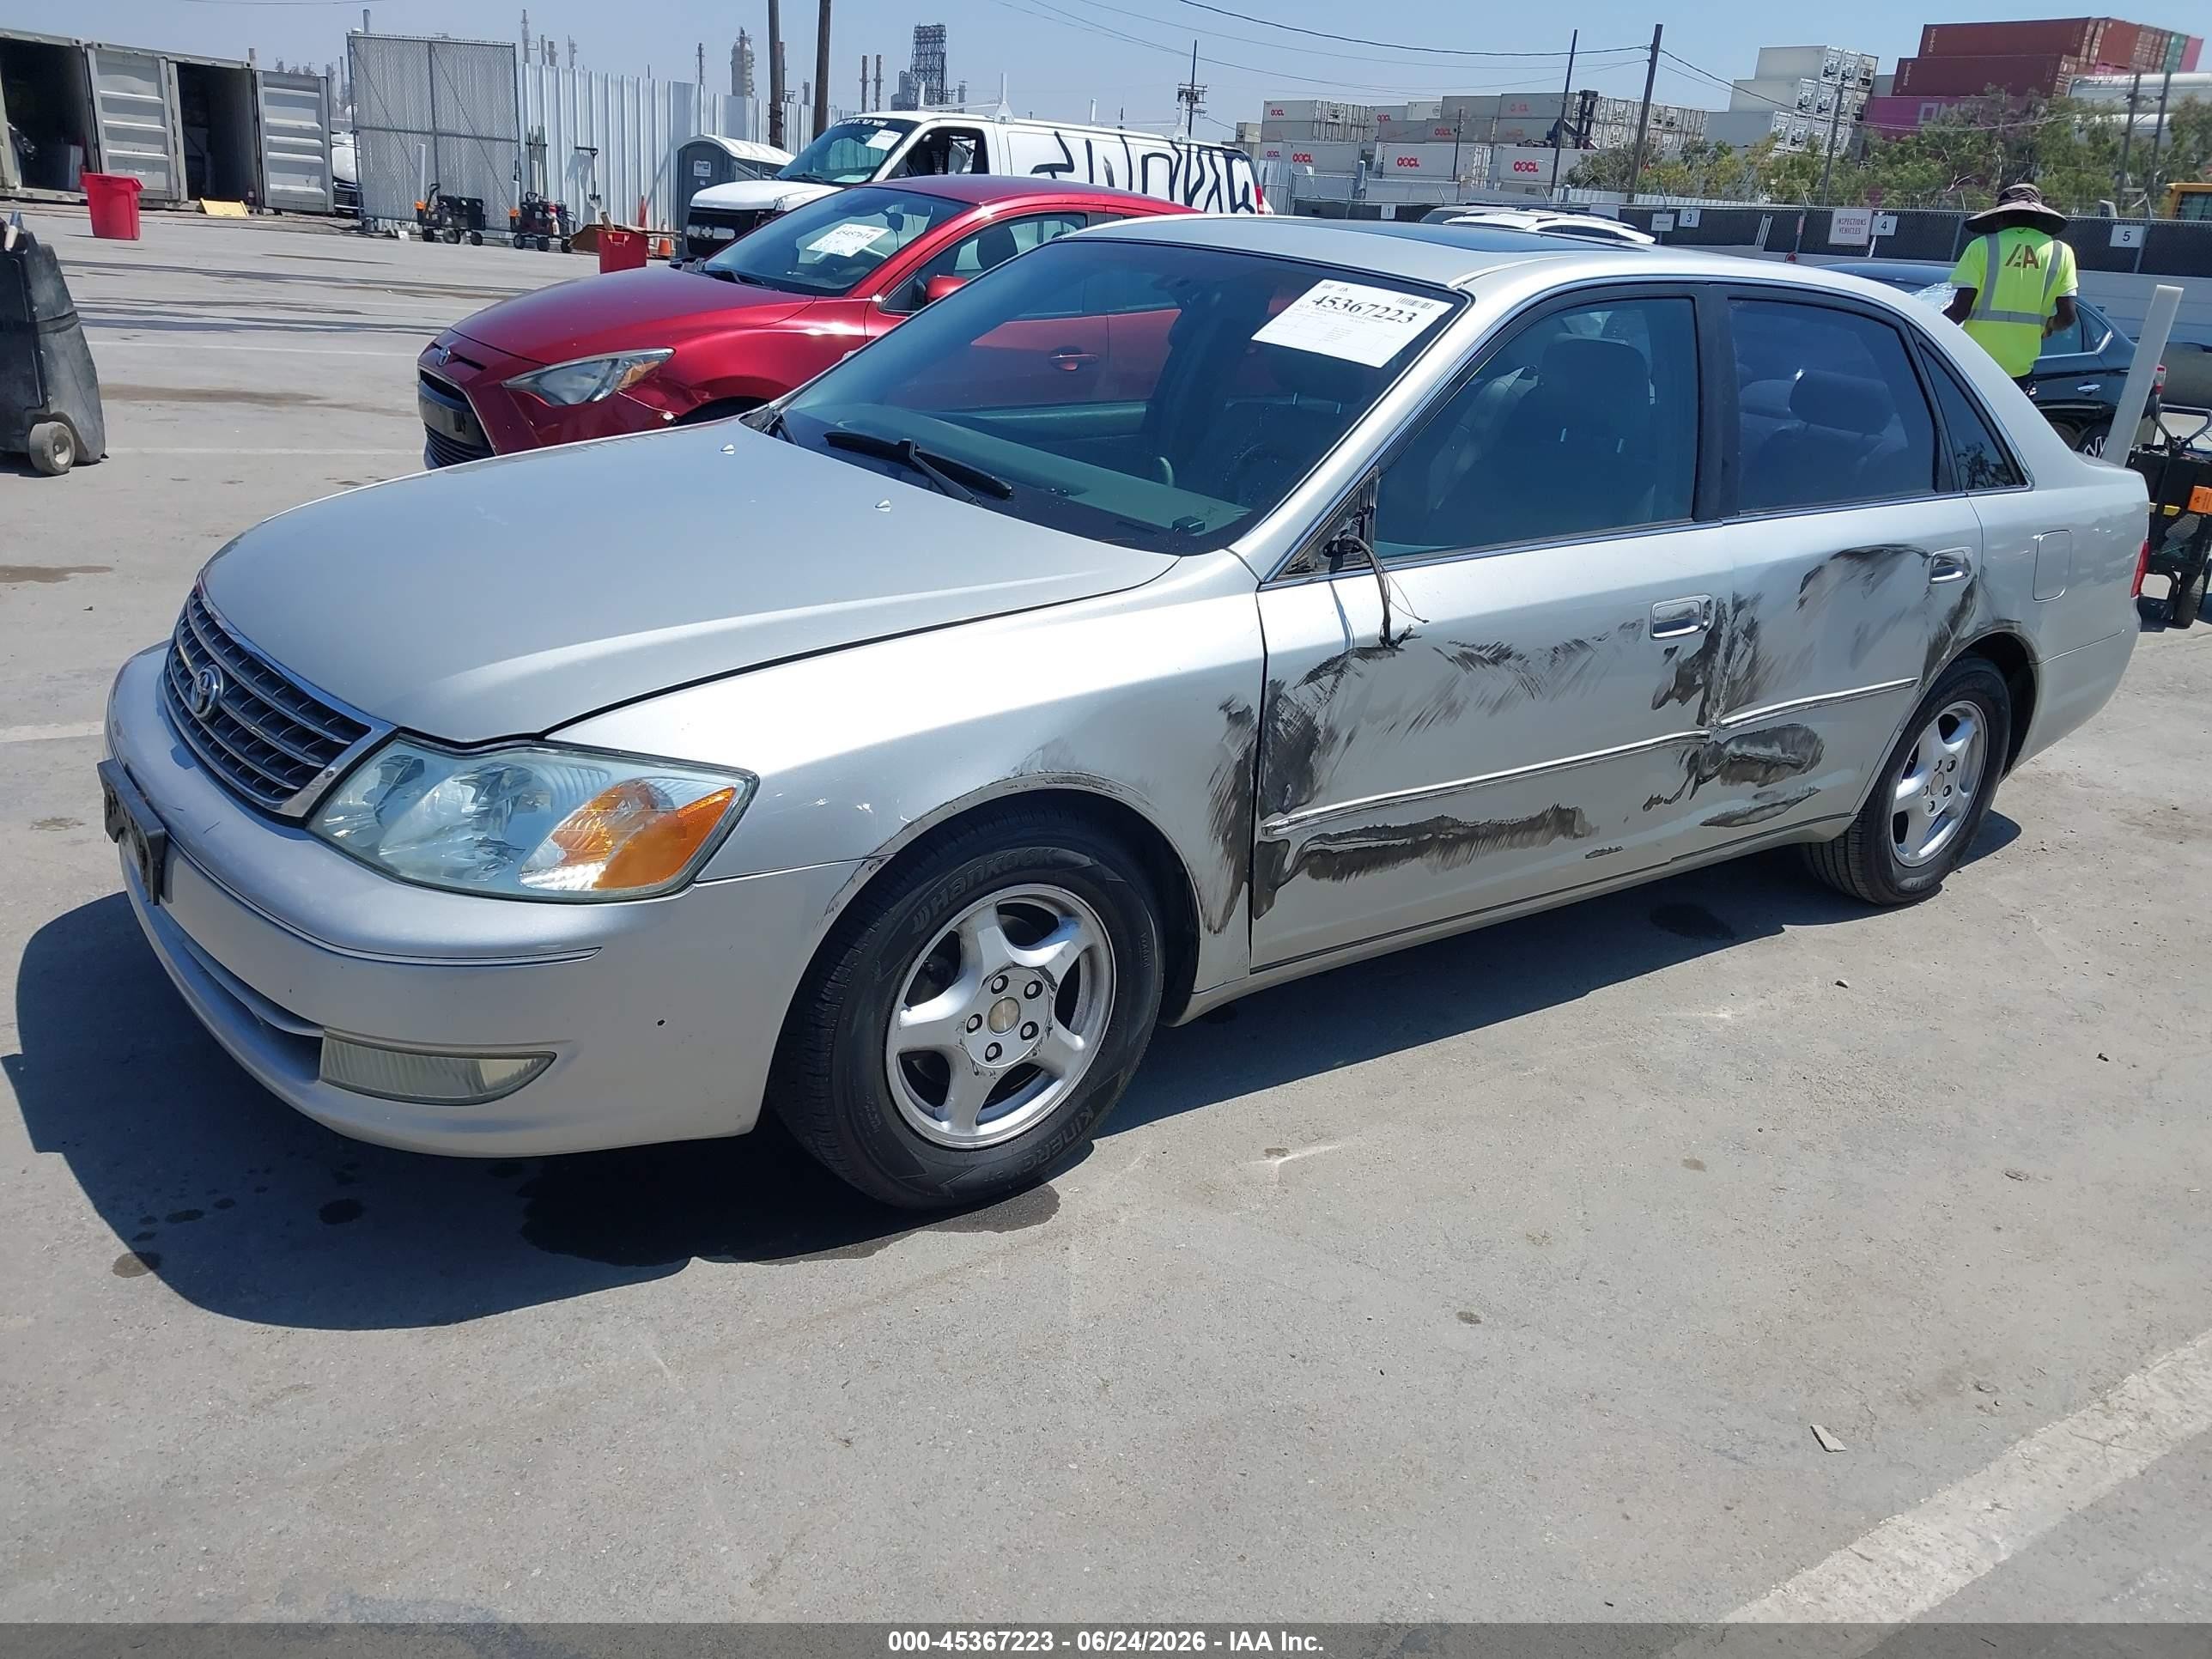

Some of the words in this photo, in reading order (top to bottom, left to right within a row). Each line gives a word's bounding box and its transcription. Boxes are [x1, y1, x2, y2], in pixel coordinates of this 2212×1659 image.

[1434, 127, 1452, 136] OOCL
[1292, 153, 1313, 163] OOCL
[1396, 157, 1419, 167] OOCL
[1513, 161, 1539, 172] OOCL
[1686, 213, 1692, 222] 3
[1881, 221, 1887, 231] 4
[2122, 230, 2131, 242] 5
[1311, 295, 1419, 325] 45367223
